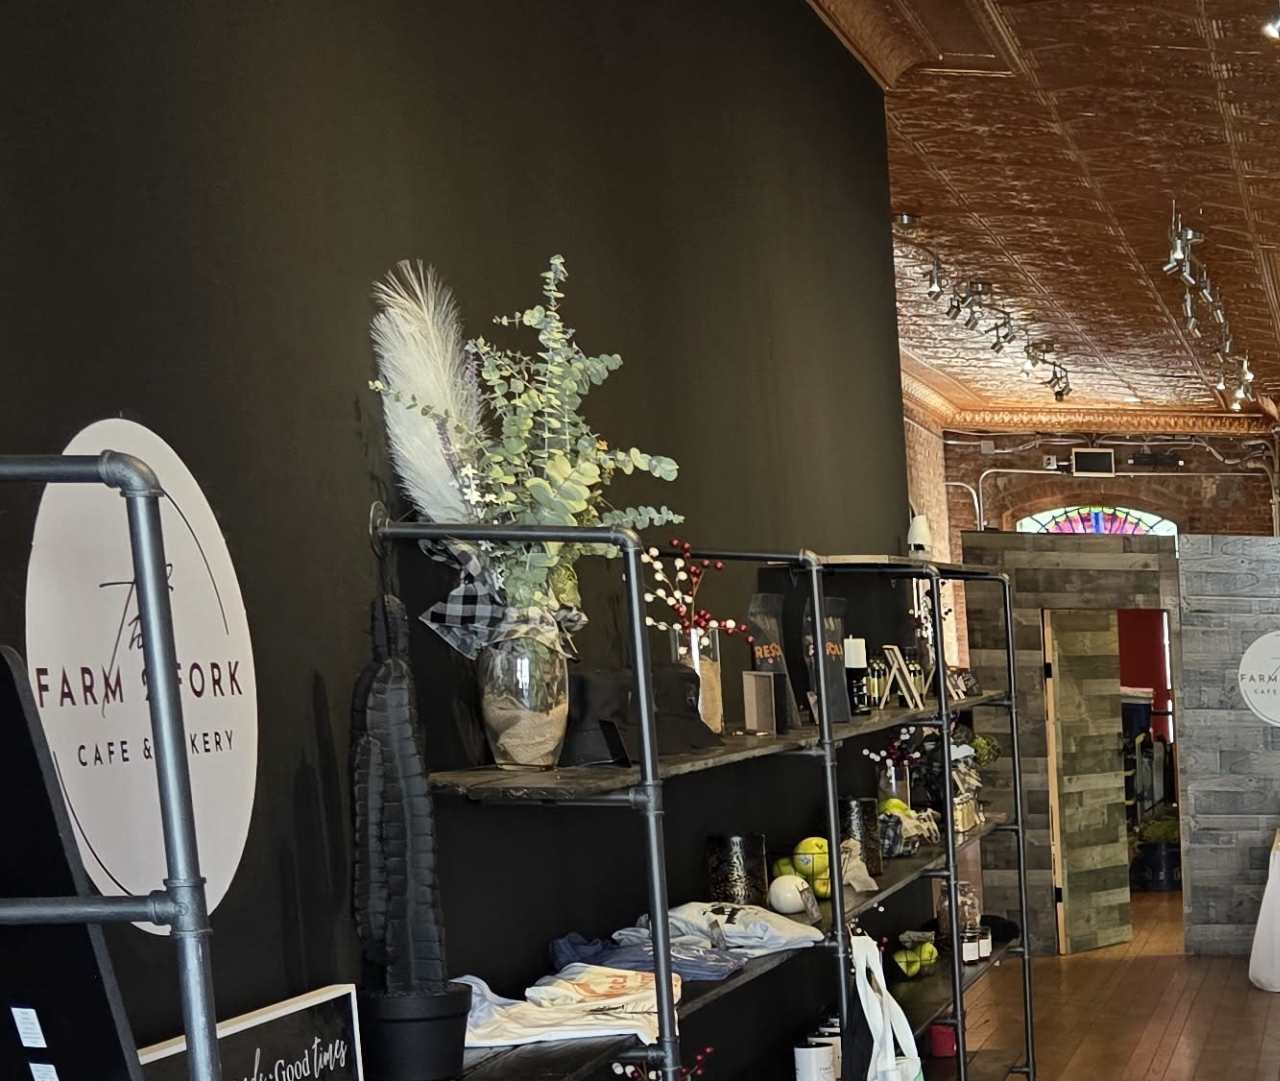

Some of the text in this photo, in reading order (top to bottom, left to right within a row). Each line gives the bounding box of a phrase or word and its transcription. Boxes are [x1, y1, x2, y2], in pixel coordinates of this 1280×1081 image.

[36, 665, 124, 708] FARM
[1239, 673, 1278, 683] FARM
[78, 730, 235, 767] CAFE & KERY
[311, 1036, 348, 1079] times
